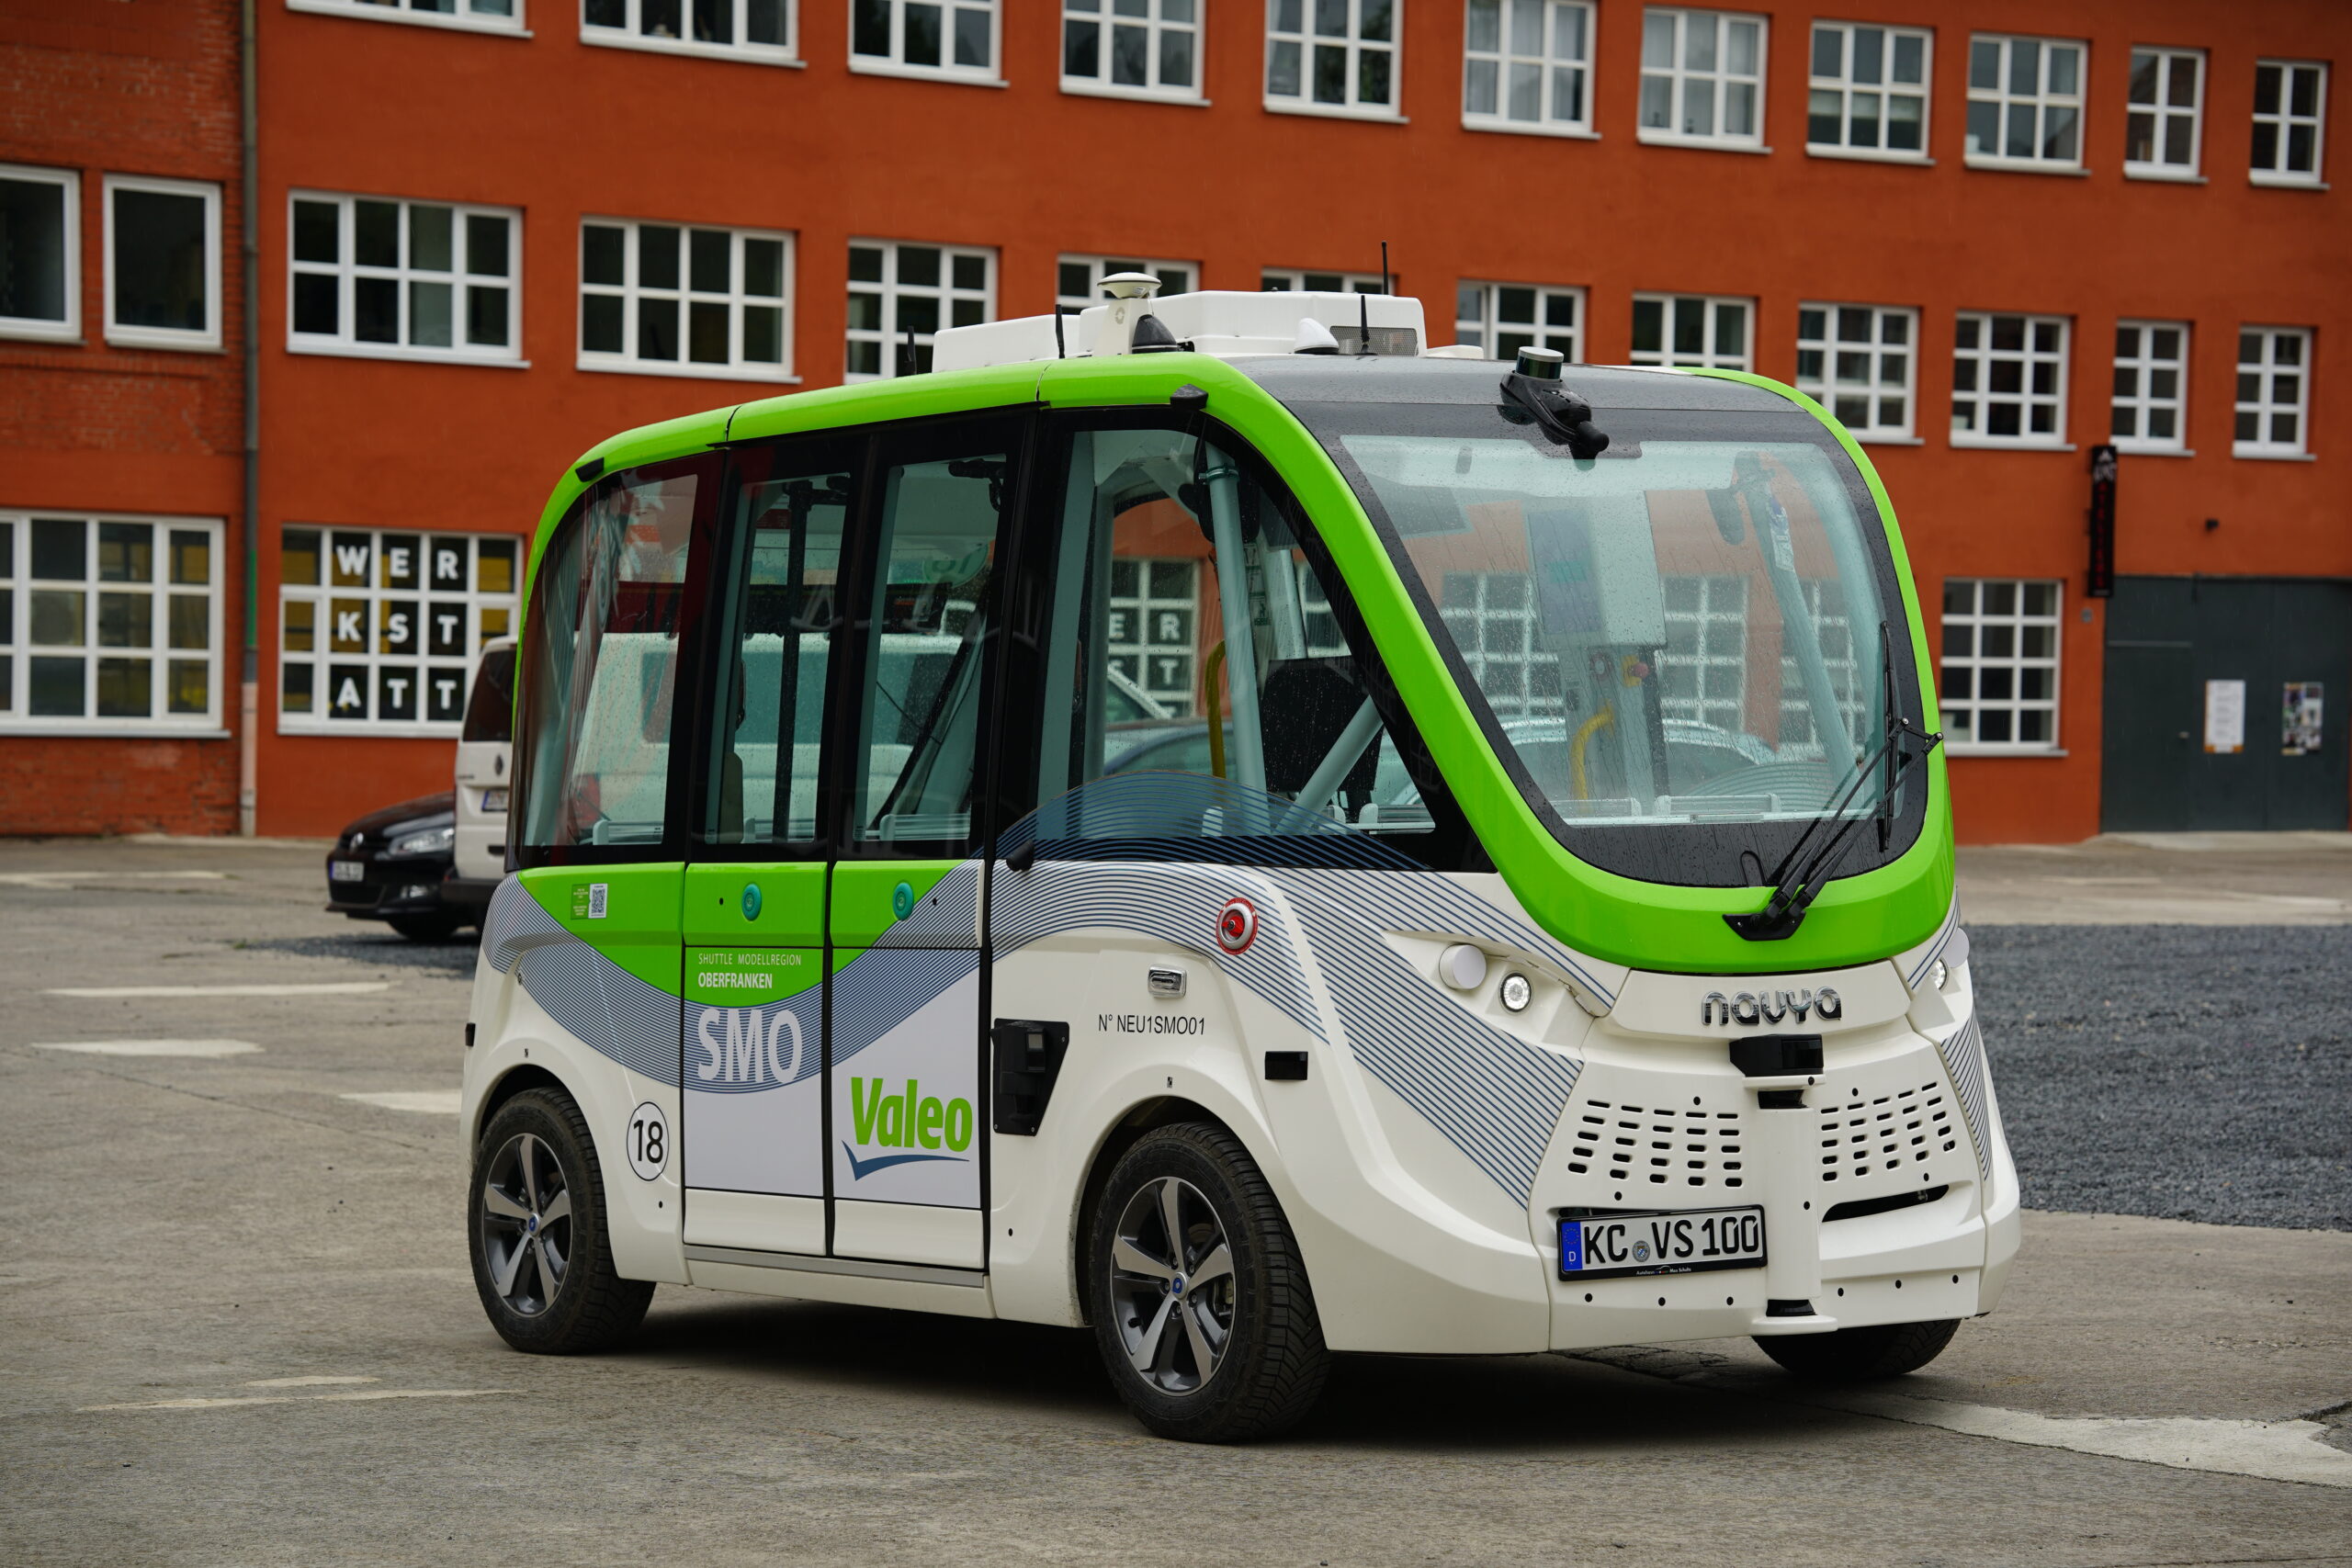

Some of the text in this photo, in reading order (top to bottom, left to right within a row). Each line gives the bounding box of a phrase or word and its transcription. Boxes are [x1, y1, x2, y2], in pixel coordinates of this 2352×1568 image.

[336, 546, 458, 580] WER
[337, 611, 458, 644] KST
[336, 677, 456, 709] ATT
[698, 953, 801, 966] SHUTTLE MODELLREGION
[697, 972, 773, 989] OBERFRANKEN
[1116, 1014, 1205, 1035] NEU1SMO01
[697, 1008, 803, 1084] SMO
[851, 1077, 973, 1153] Valeo
[633, 1119, 664, 1164] 18
[1584, 1214, 1758, 1265] KC VS 100
[1568, 1250, 1577, 1263] D
